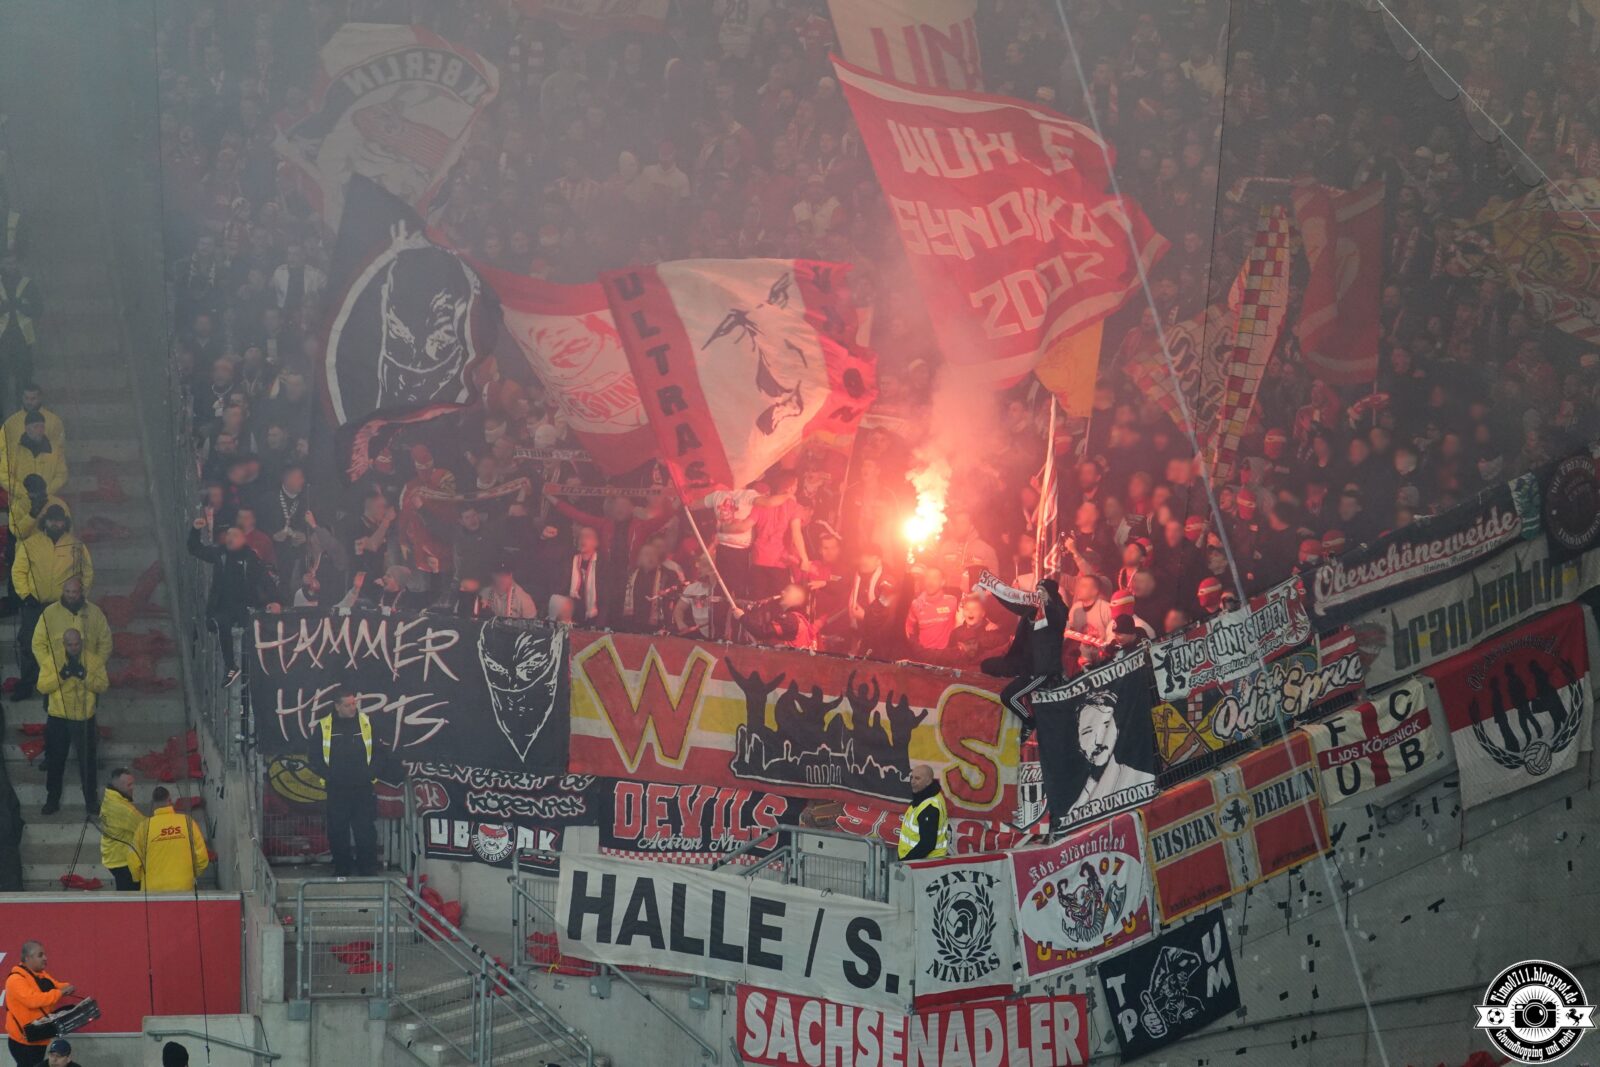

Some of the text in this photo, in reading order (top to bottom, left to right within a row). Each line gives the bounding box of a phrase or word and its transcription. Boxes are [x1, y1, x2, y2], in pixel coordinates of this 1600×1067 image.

[886, 119, 1076, 180] WUHE
[889, 187, 1134, 261] SYNDIKAT
[969, 251, 1106, 340] 2002
[613, 271, 713, 489] ULTRAS
[1313, 505, 1521, 602] Oberschöneweide
[253, 617, 459, 682] HAMMER
[1169, 597, 1291, 676] EINS FÜNF SIEBEN
[1031, 650, 1146, 704] EINMAL UNIONER
[1213, 651, 1365, 738] Oder Spree
[276, 683, 449, 752] HERTS
[574, 635, 1008, 811] W S
[1326, 718, 1422, 766] LADS KÖPENICK
[613, 780, 788, 851] DEVILS
[1103, 783, 1160, 811] UNIONE
[1151, 812, 1219, 863] EISERN
[1252, 767, 1318, 819] BERLIN
[637, 831, 703, 852] Action
[925, 870, 1001, 899] SIXTY
[567, 871, 901, 994] HALLE / S.
[926, 952, 1001, 983] NINERS
[741, 990, 1085, 1067] SACHSENADLER
